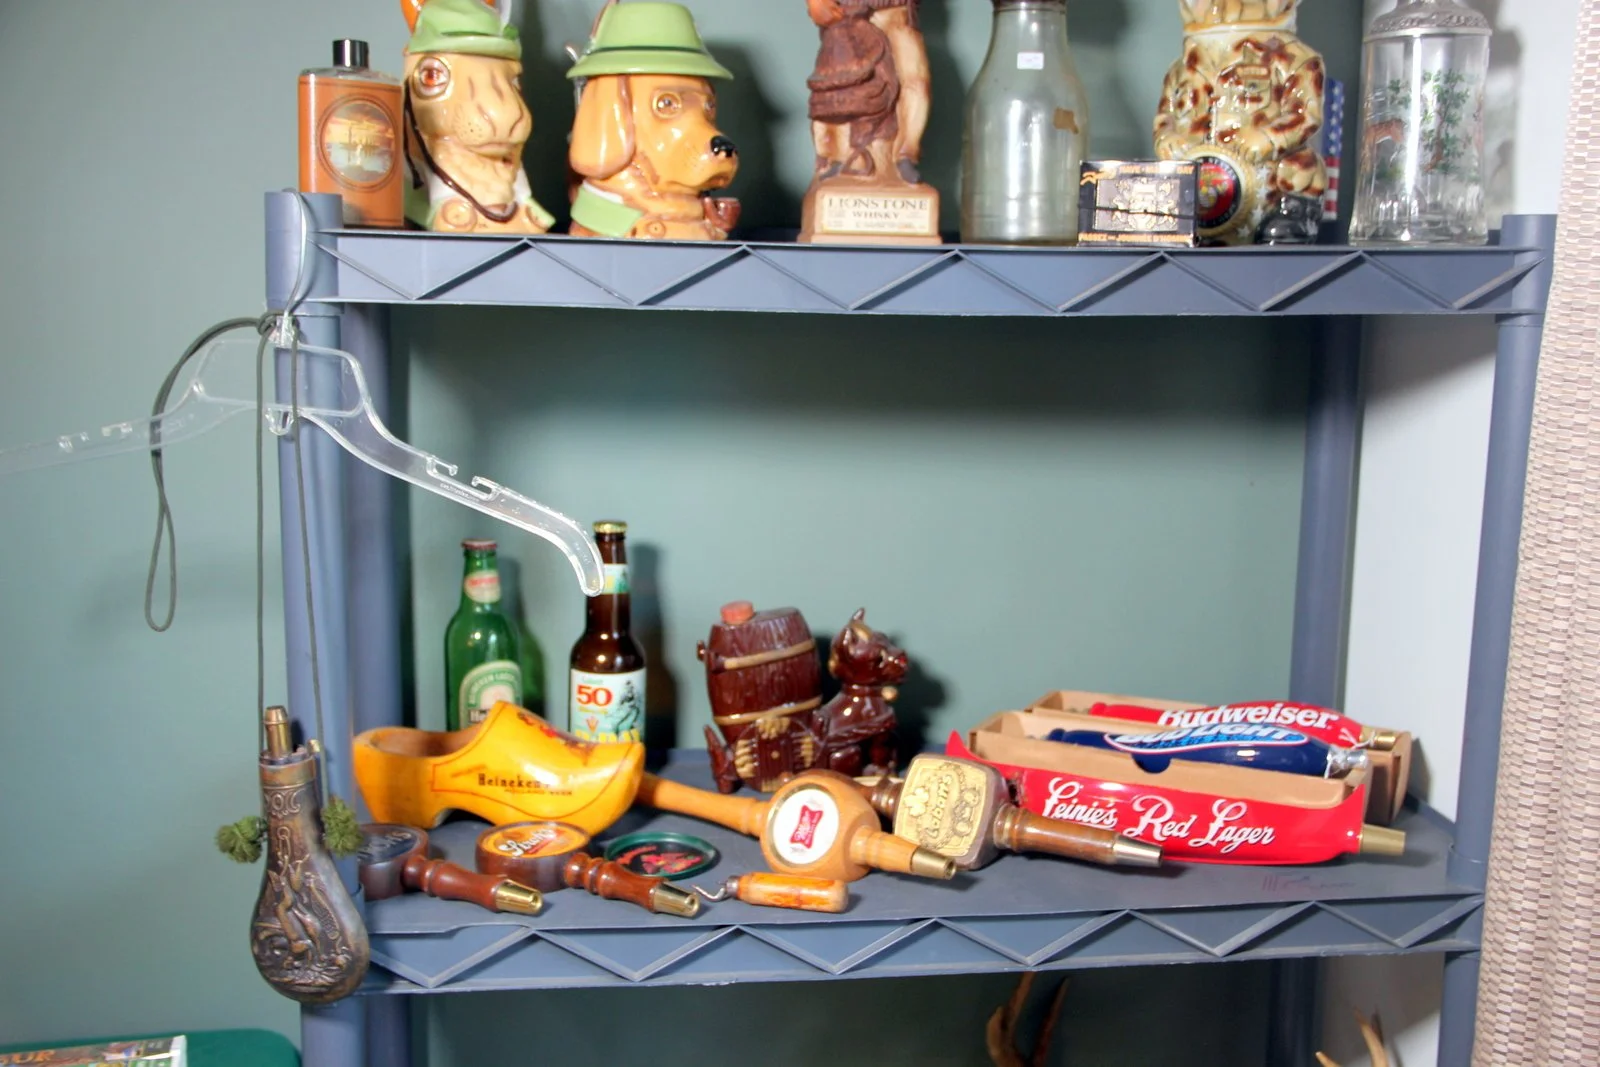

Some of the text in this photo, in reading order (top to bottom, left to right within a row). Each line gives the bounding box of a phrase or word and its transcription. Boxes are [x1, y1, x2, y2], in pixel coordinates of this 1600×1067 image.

[827, 197, 928, 211] LIONSTONE
[852, 210, 900, 220] WHISKY
[576, 684, 613, 707] 50
[1157, 702, 1338, 728] Budweiser
[1042, 777, 1275, 853] Leinie's Red Lager
